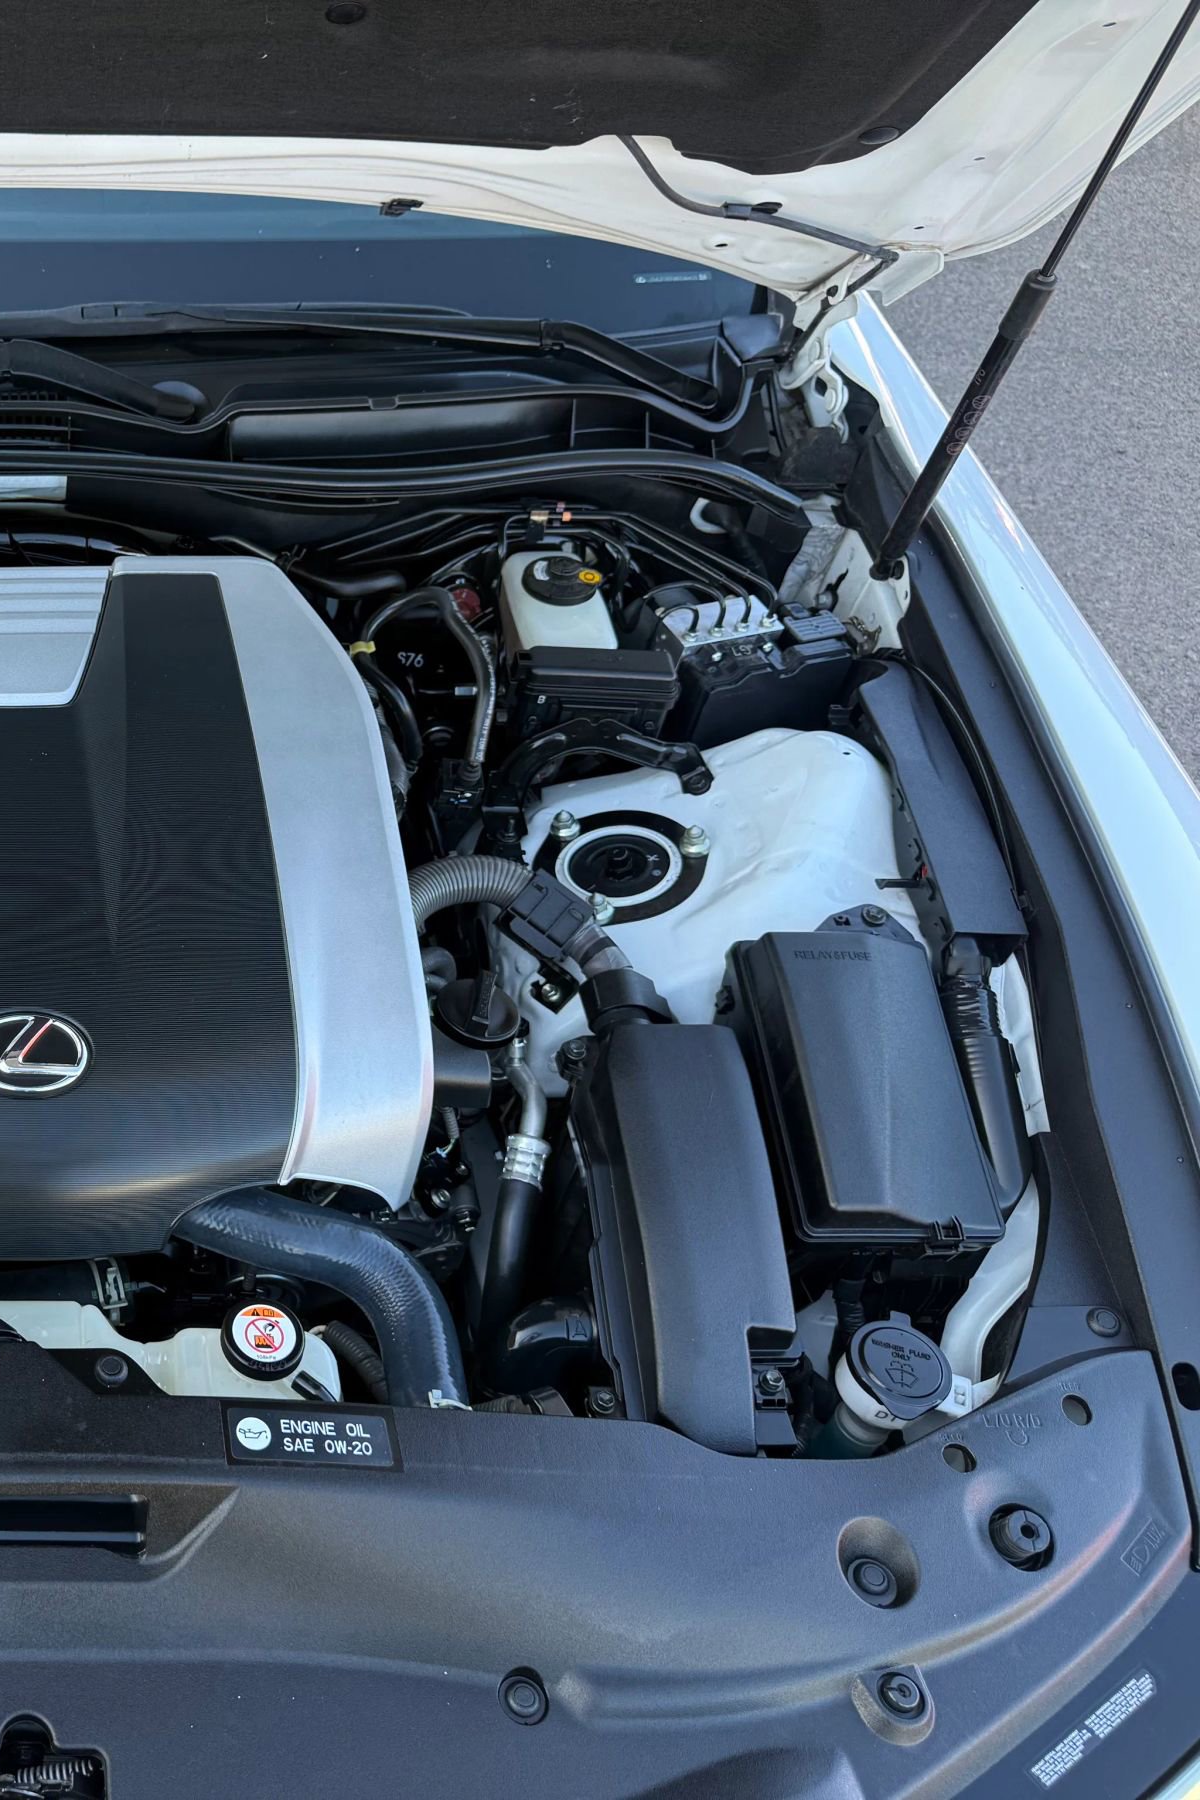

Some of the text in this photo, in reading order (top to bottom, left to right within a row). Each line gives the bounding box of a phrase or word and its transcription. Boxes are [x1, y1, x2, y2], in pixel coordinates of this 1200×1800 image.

[537, 695, 547, 704] B
[793, 949, 873, 962] RELAY&FUSE
[871, 1338, 931, 1361] WASHER FLUID
[891, 1351, 911, 1361] ONLY
[280, 1418, 371, 1438] ENGINE OIL
[283, 1438, 373, 1456] SAE 0W-20
